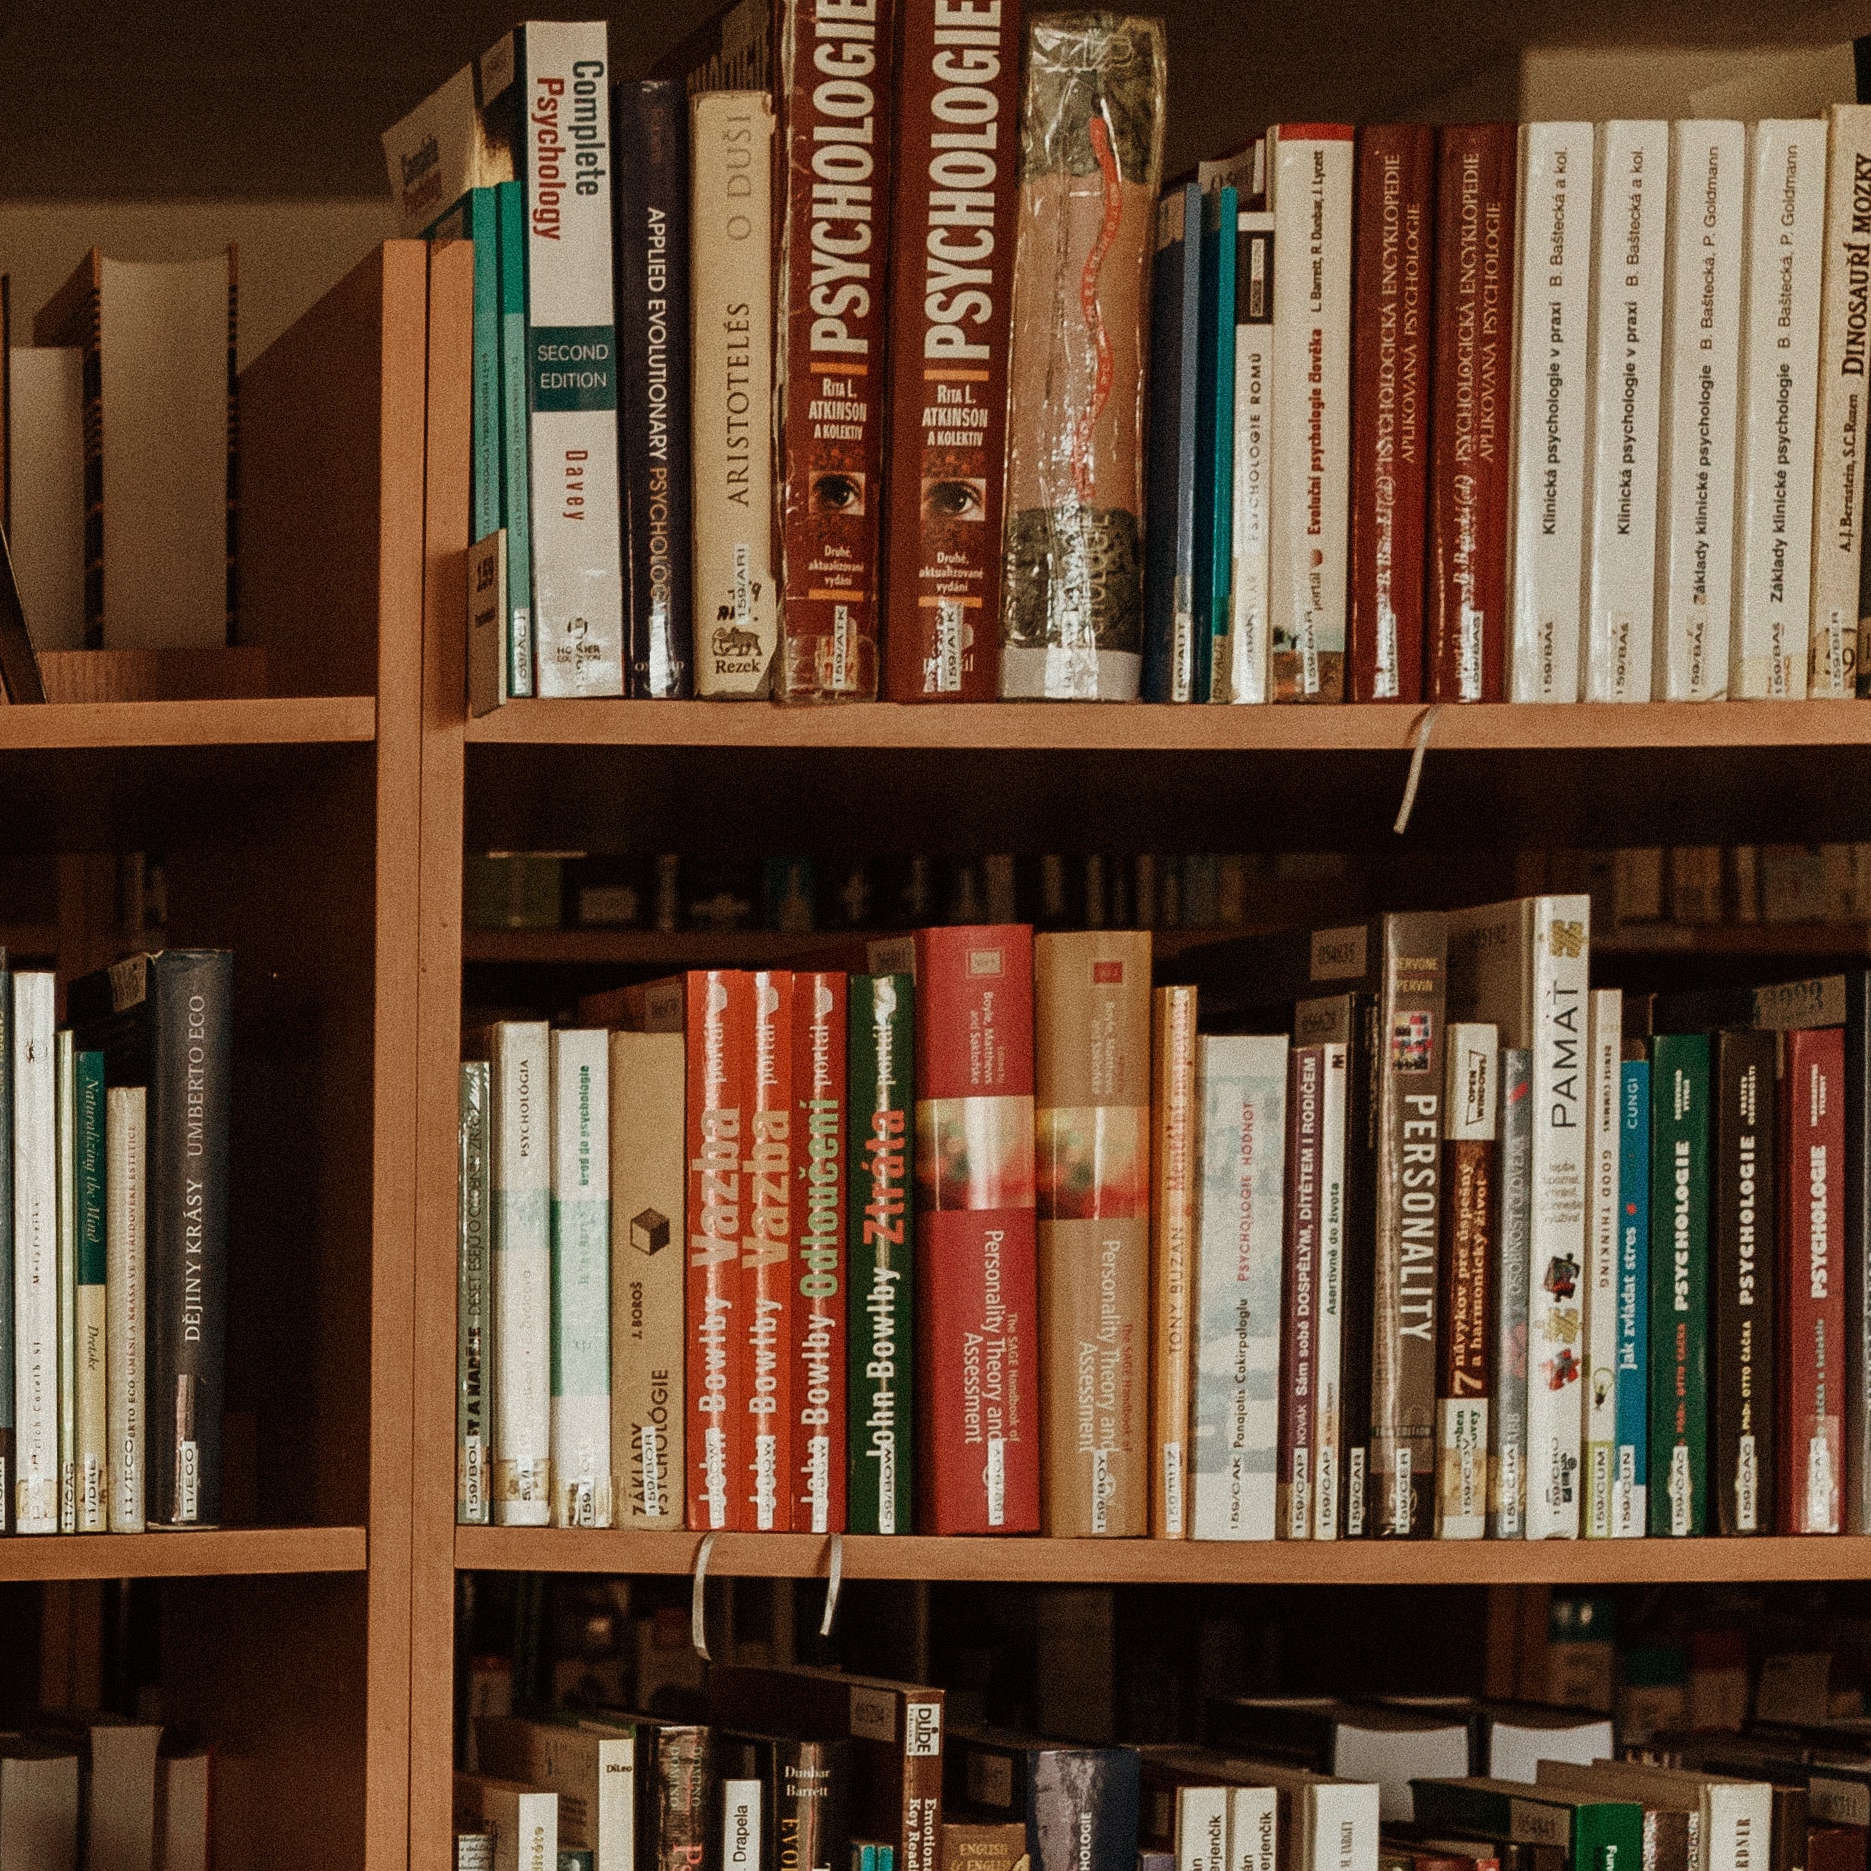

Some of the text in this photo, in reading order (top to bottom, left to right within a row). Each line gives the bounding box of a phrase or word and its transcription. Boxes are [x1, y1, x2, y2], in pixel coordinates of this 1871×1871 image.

[536, 77, 565, 242] Psychology
[571, 60, 599, 196] Complete
[537, 345, 608, 361] SECOND
[725, 114, 752, 507] ARISTOTELÉS O DUŠI
[540, 371, 605, 388] EDITION
[922, 407, 987, 429] ATKINSON
[563, 450, 588, 520] Davey
[715, 659, 760, 676] Rezek
[863, 1111, 904, 1378] Bowlby Ztráta
[1400, 1094, 1437, 1341] PERSONALITY
[1739, 1137, 1753, 1305] PSYCHOLOGIE
